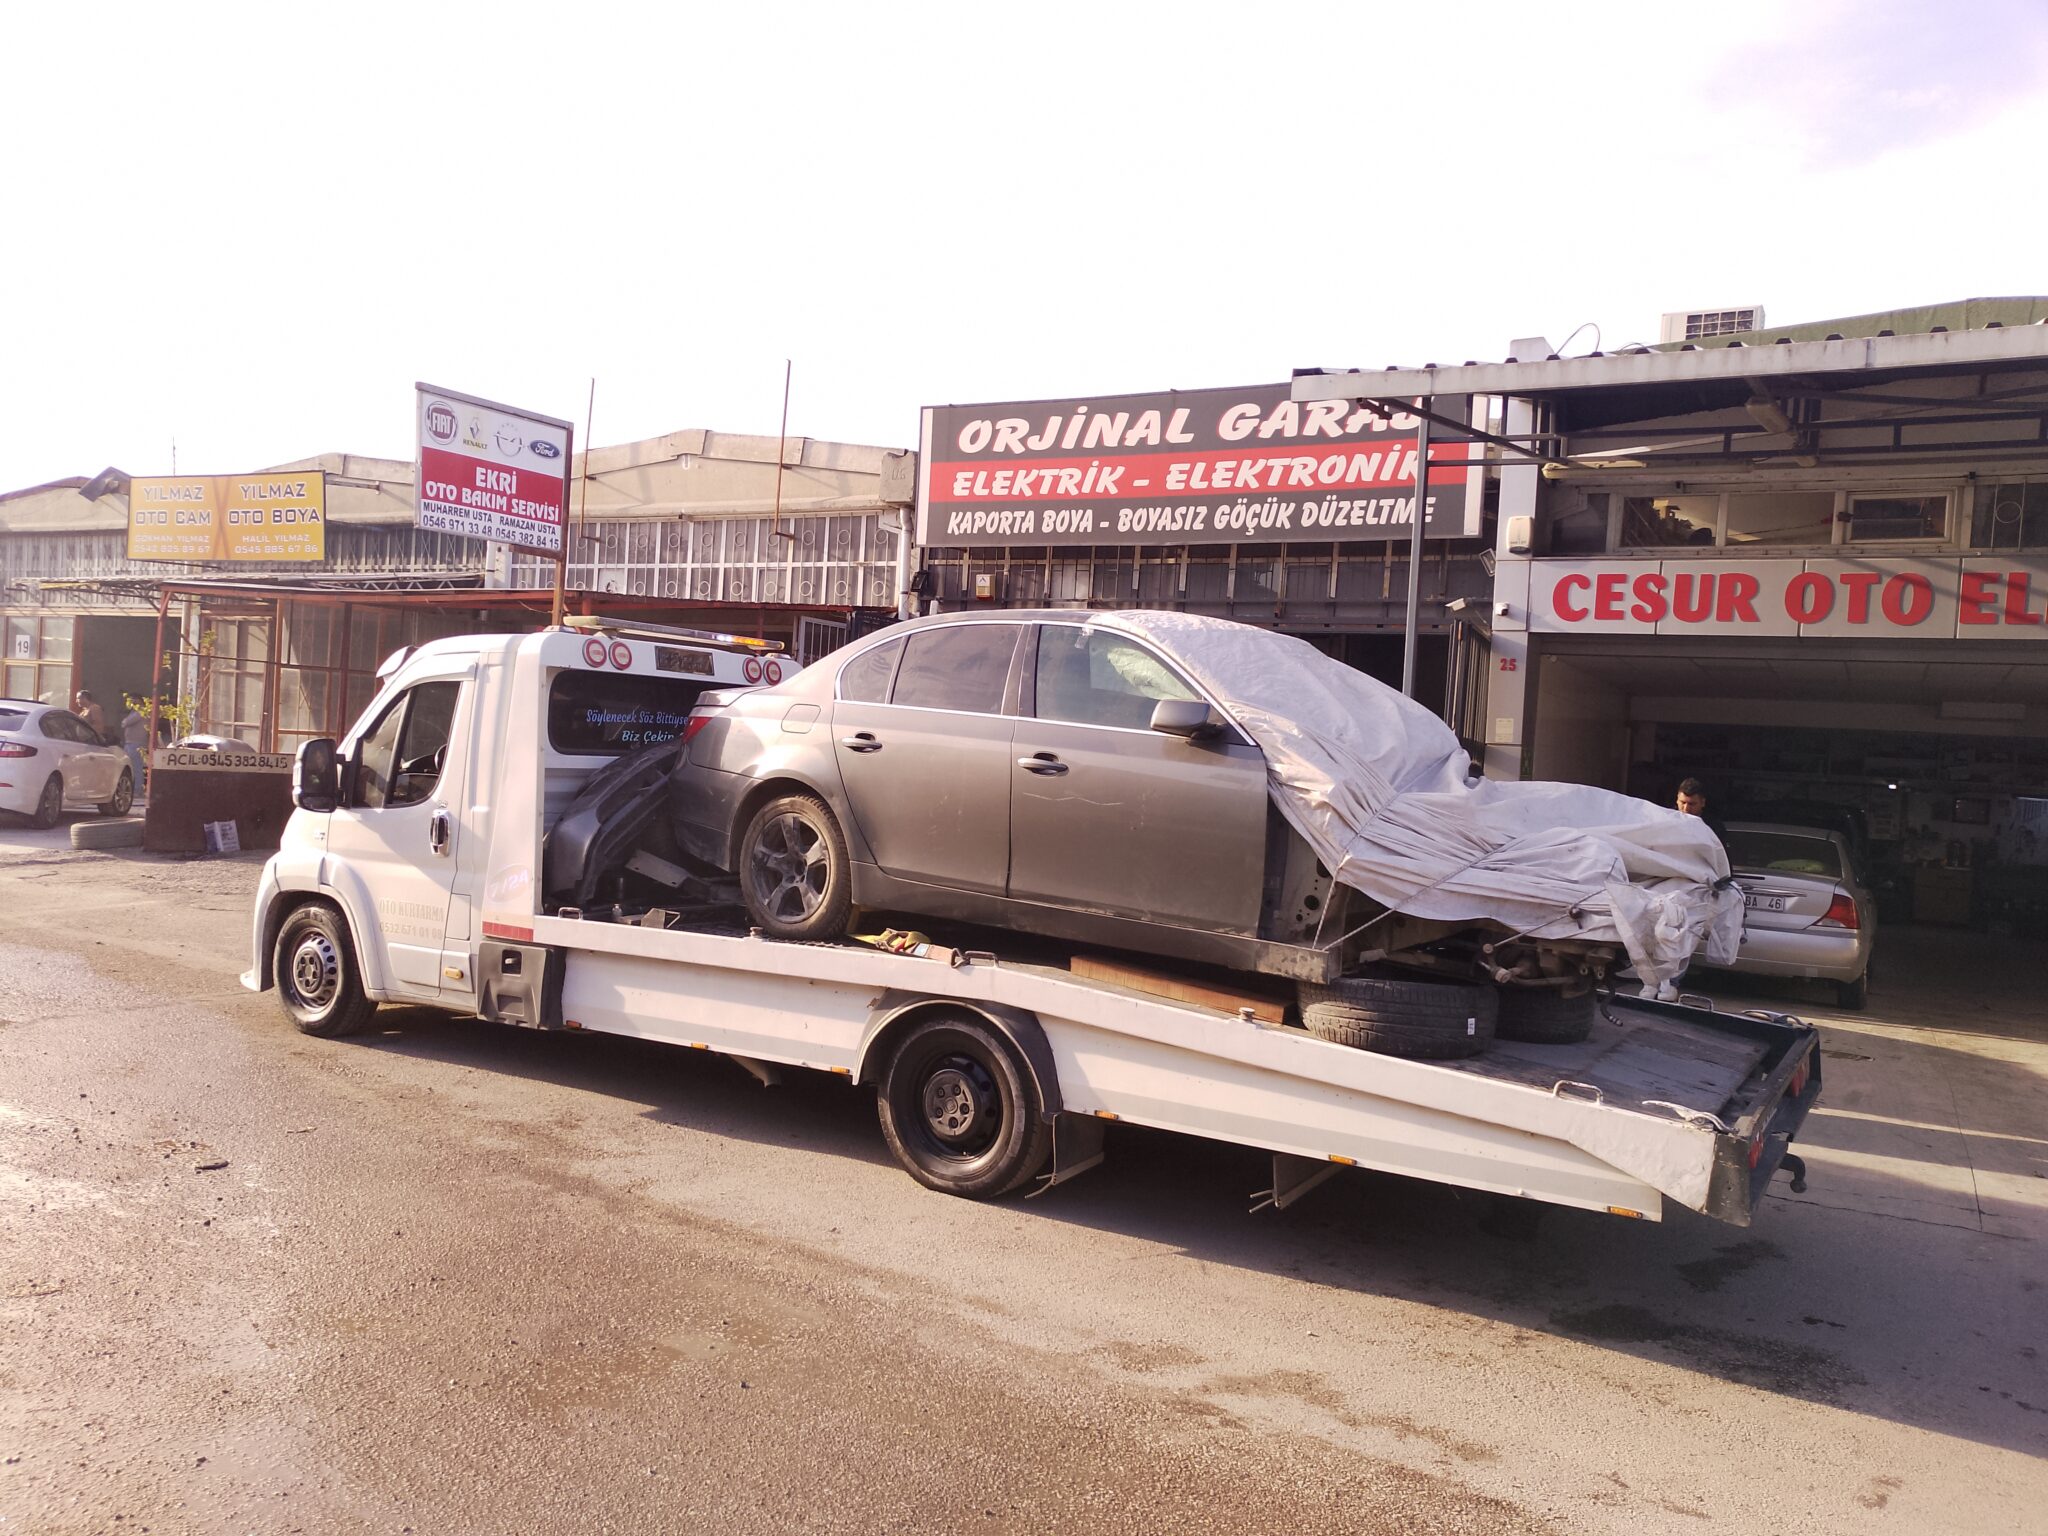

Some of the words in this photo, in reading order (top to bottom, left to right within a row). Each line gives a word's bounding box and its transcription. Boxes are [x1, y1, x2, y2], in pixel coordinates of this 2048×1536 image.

[431, 412, 453, 435] FIAT
[958, 405, 1195, 454] ORJİNAL
[463, 439, 488, 450] RENAULT
[535, 442, 555, 458] Ford
[952, 460, 1126, 497] ELEKTRİK
[1166, 444, 1435, 490] ELEKTRONİK
[475, 466, 518, 496] EKRİ
[143, 486, 204, 501] YILMAZ
[240, 483, 306, 499] YILMAZ
[425, 480, 458, 501] OTO
[461, 487, 507, 512] BAKIM
[511, 498, 559, 522] SERVİSİ
[135, 510, 168, 525] OTO
[175, 510, 212, 525] CAM
[228, 509, 264, 525] OTO
[272, 508, 321, 524] BOYA
[423, 501, 471, 519] MUHARREM
[472, 509, 493, 523] USTA
[500, 515, 536, 532] RAMAZAN
[537, 523, 557, 536] USTA
[947, 509, 1035, 536] KAPORTA
[1041, 509, 1094, 534] BOYA
[1117, 505, 1208, 532] BOYASIZ
[1213, 496, 1296, 536] GÖÇÜK
[1301, 494, 1436, 529] DÜZELTME
[177, 535, 210, 543] YILMAZ
[242, 532, 270, 543] HALİL
[275, 534, 310, 542] YILMAZ
[423, 514, 446, 529] 0546
[448, 518, 466, 532] 971
[468, 522, 479, 535] 33
[481, 525, 492, 537] 48
[495, 527, 517, 541] 0545
[518, 531, 534, 546] 382
[536, 535, 548, 547] 84
[550, 538, 560, 550] 15
[1552, 572, 1760, 624] CESUR
[1784, 572, 1934, 626] OTO
[1959, 571, 2048, 625] EL
[17, 640, 29, 654] 19
[1500, 657, 1517, 672] 25
[586, 708, 637, 727] Söylenecek
[639, 710, 654, 724] Söz
[621, 730, 640, 742] Biz
[1768, 897, 1782, 909] 46
